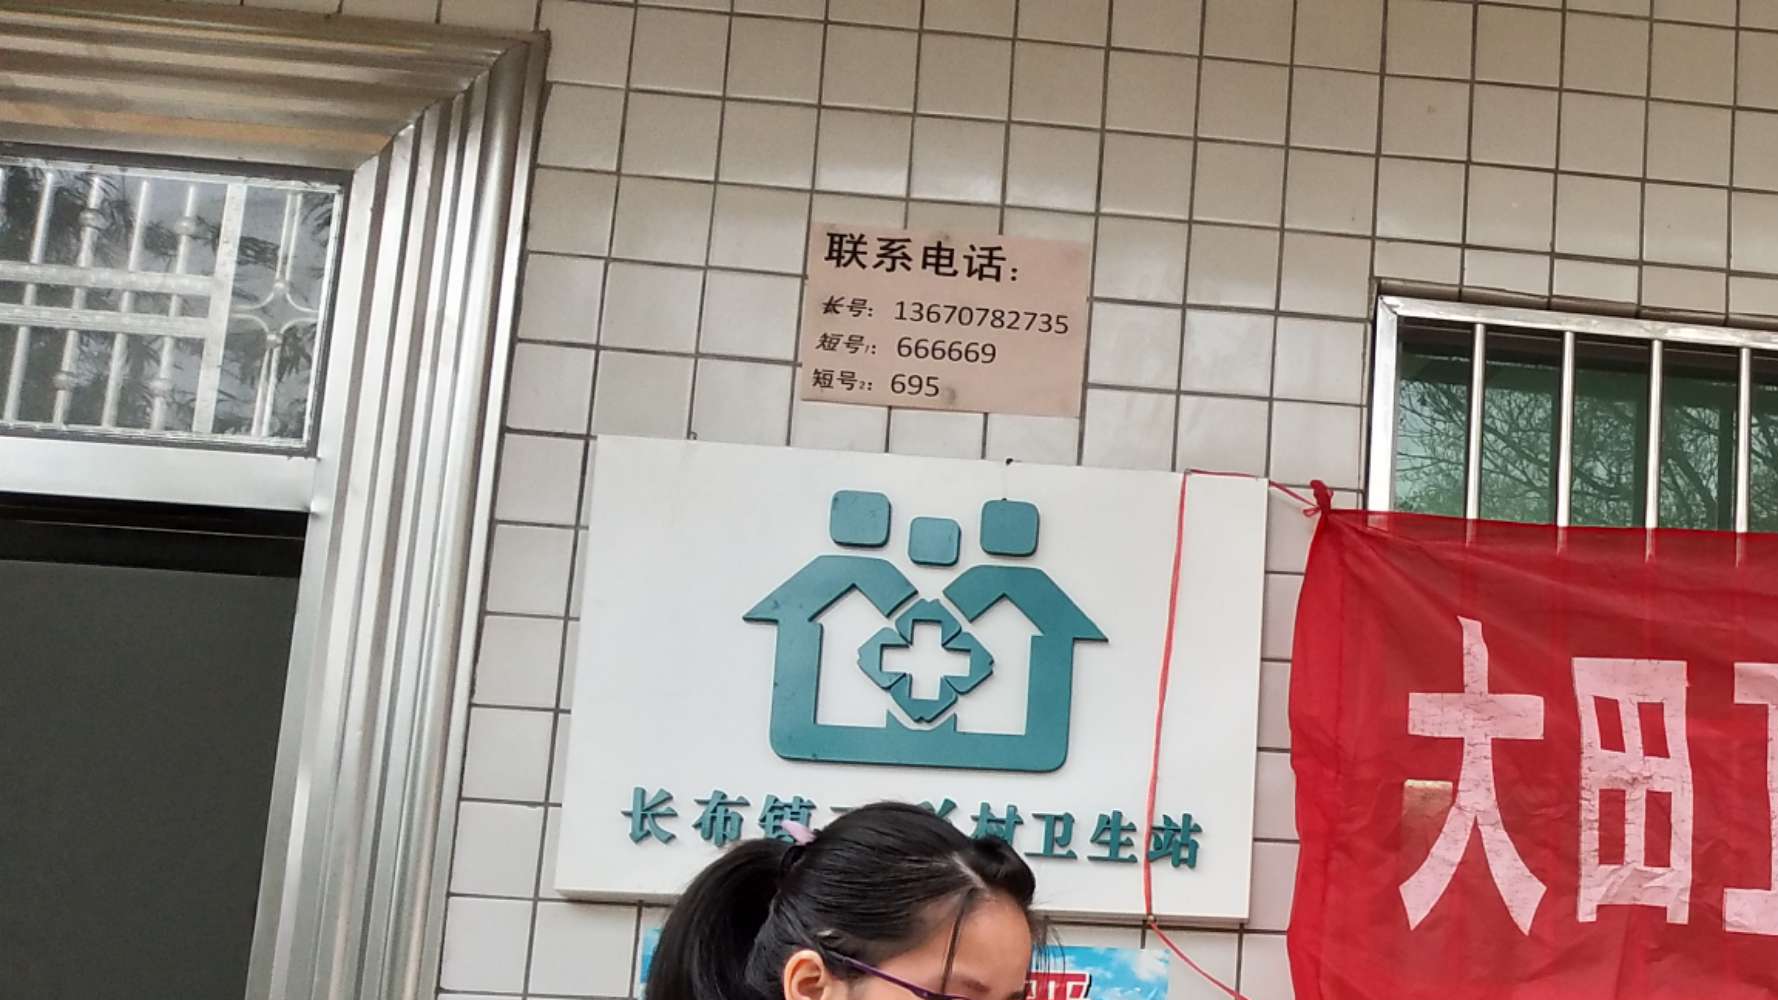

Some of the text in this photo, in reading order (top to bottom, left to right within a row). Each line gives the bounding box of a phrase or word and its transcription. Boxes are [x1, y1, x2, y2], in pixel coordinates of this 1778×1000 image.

[824, 232, 1018, 282] 联系电话：
[822, 295, 1069, 334] 长号： 13670782735
[897, 337, 996, 364] 666669
[891, 374, 940, 397] 695
[621, 786, 1202, 869] 长布镇村卫生站
